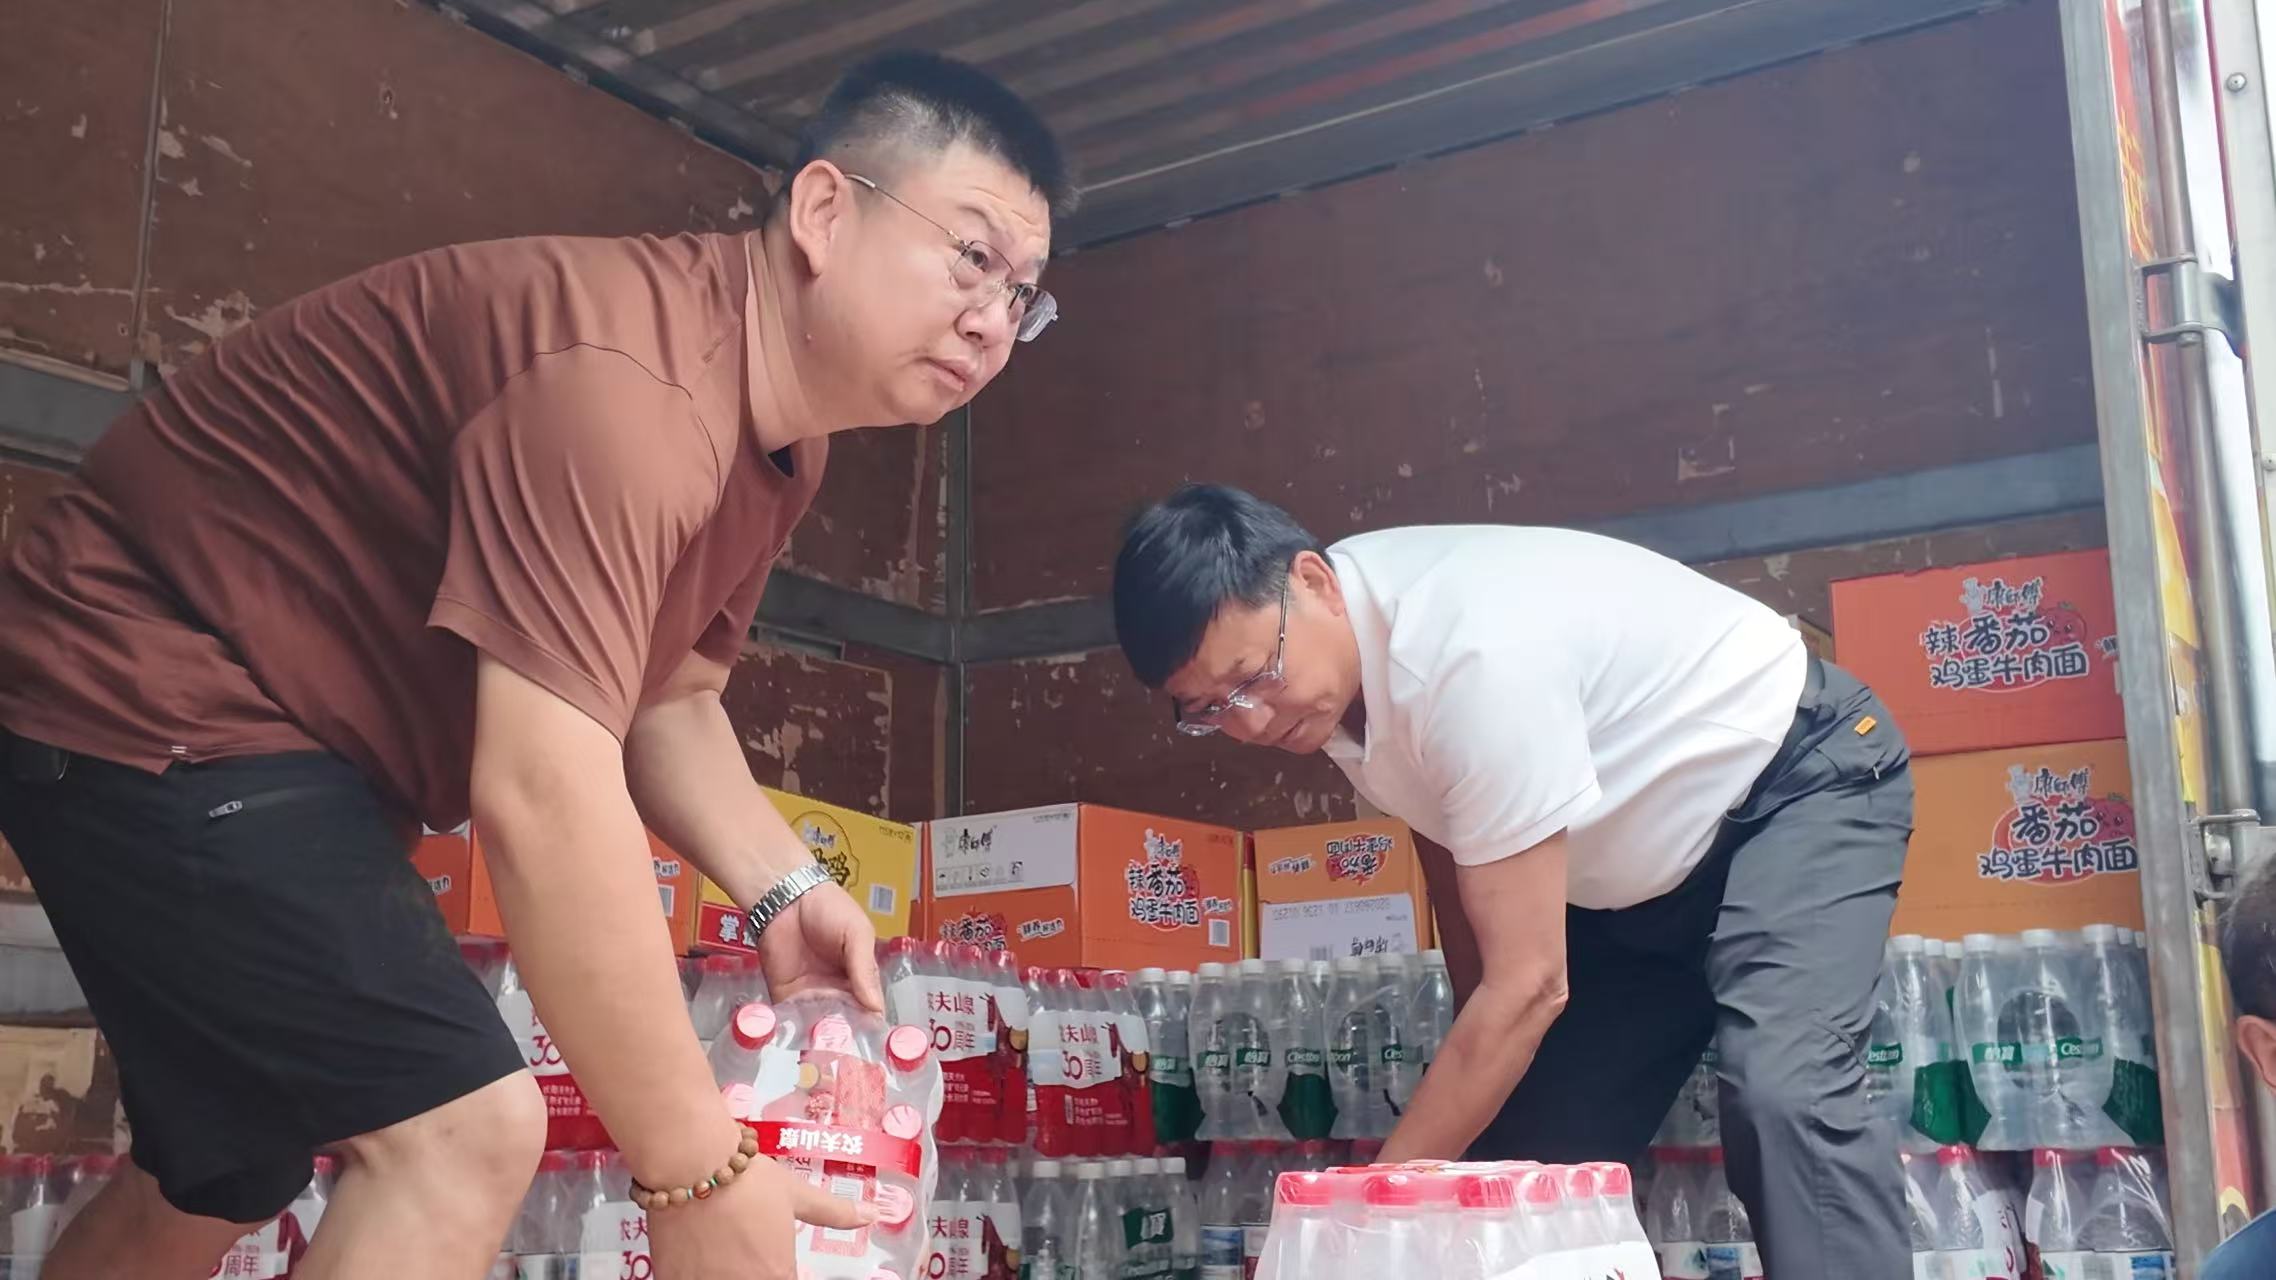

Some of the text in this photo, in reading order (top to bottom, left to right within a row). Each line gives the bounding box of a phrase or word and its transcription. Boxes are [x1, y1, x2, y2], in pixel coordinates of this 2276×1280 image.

[1925, 611, 2049, 656] 辣番茄
[1931, 644, 2088, 688] 鸡蛋牛肉面
[2012, 801, 2097, 845] 番茄
[1979, 838, 2138, 879] 鸡蛋牛肉面
[1128, 863, 1186, 898] 辣番茄
[1130, 897, 1200, 925] 鸡蛋牛肉面
[776, 1127, 864, 1155] 农夫山泉
